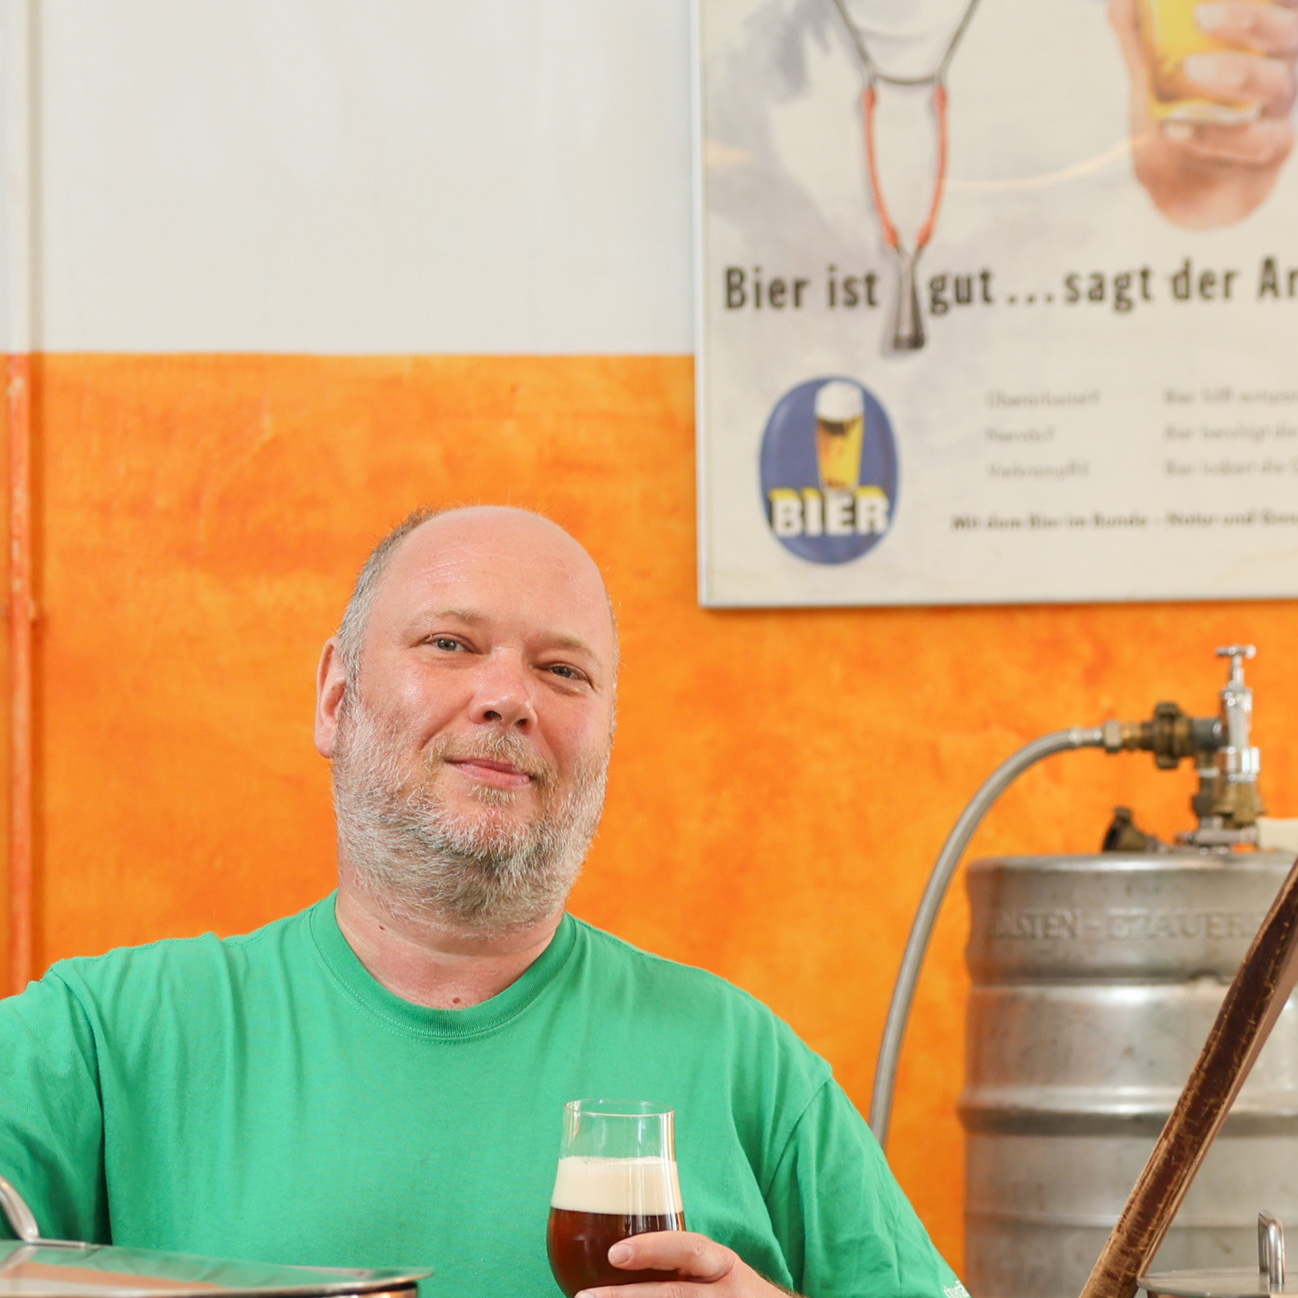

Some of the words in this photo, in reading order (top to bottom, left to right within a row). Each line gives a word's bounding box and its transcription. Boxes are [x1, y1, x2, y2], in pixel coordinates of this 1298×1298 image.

[725, 264, 809, 310] Bier
[827, 264, 879, 309] ist
[1169, 256, 1239, 302] der
[769, 484, 890, 538] BIER
